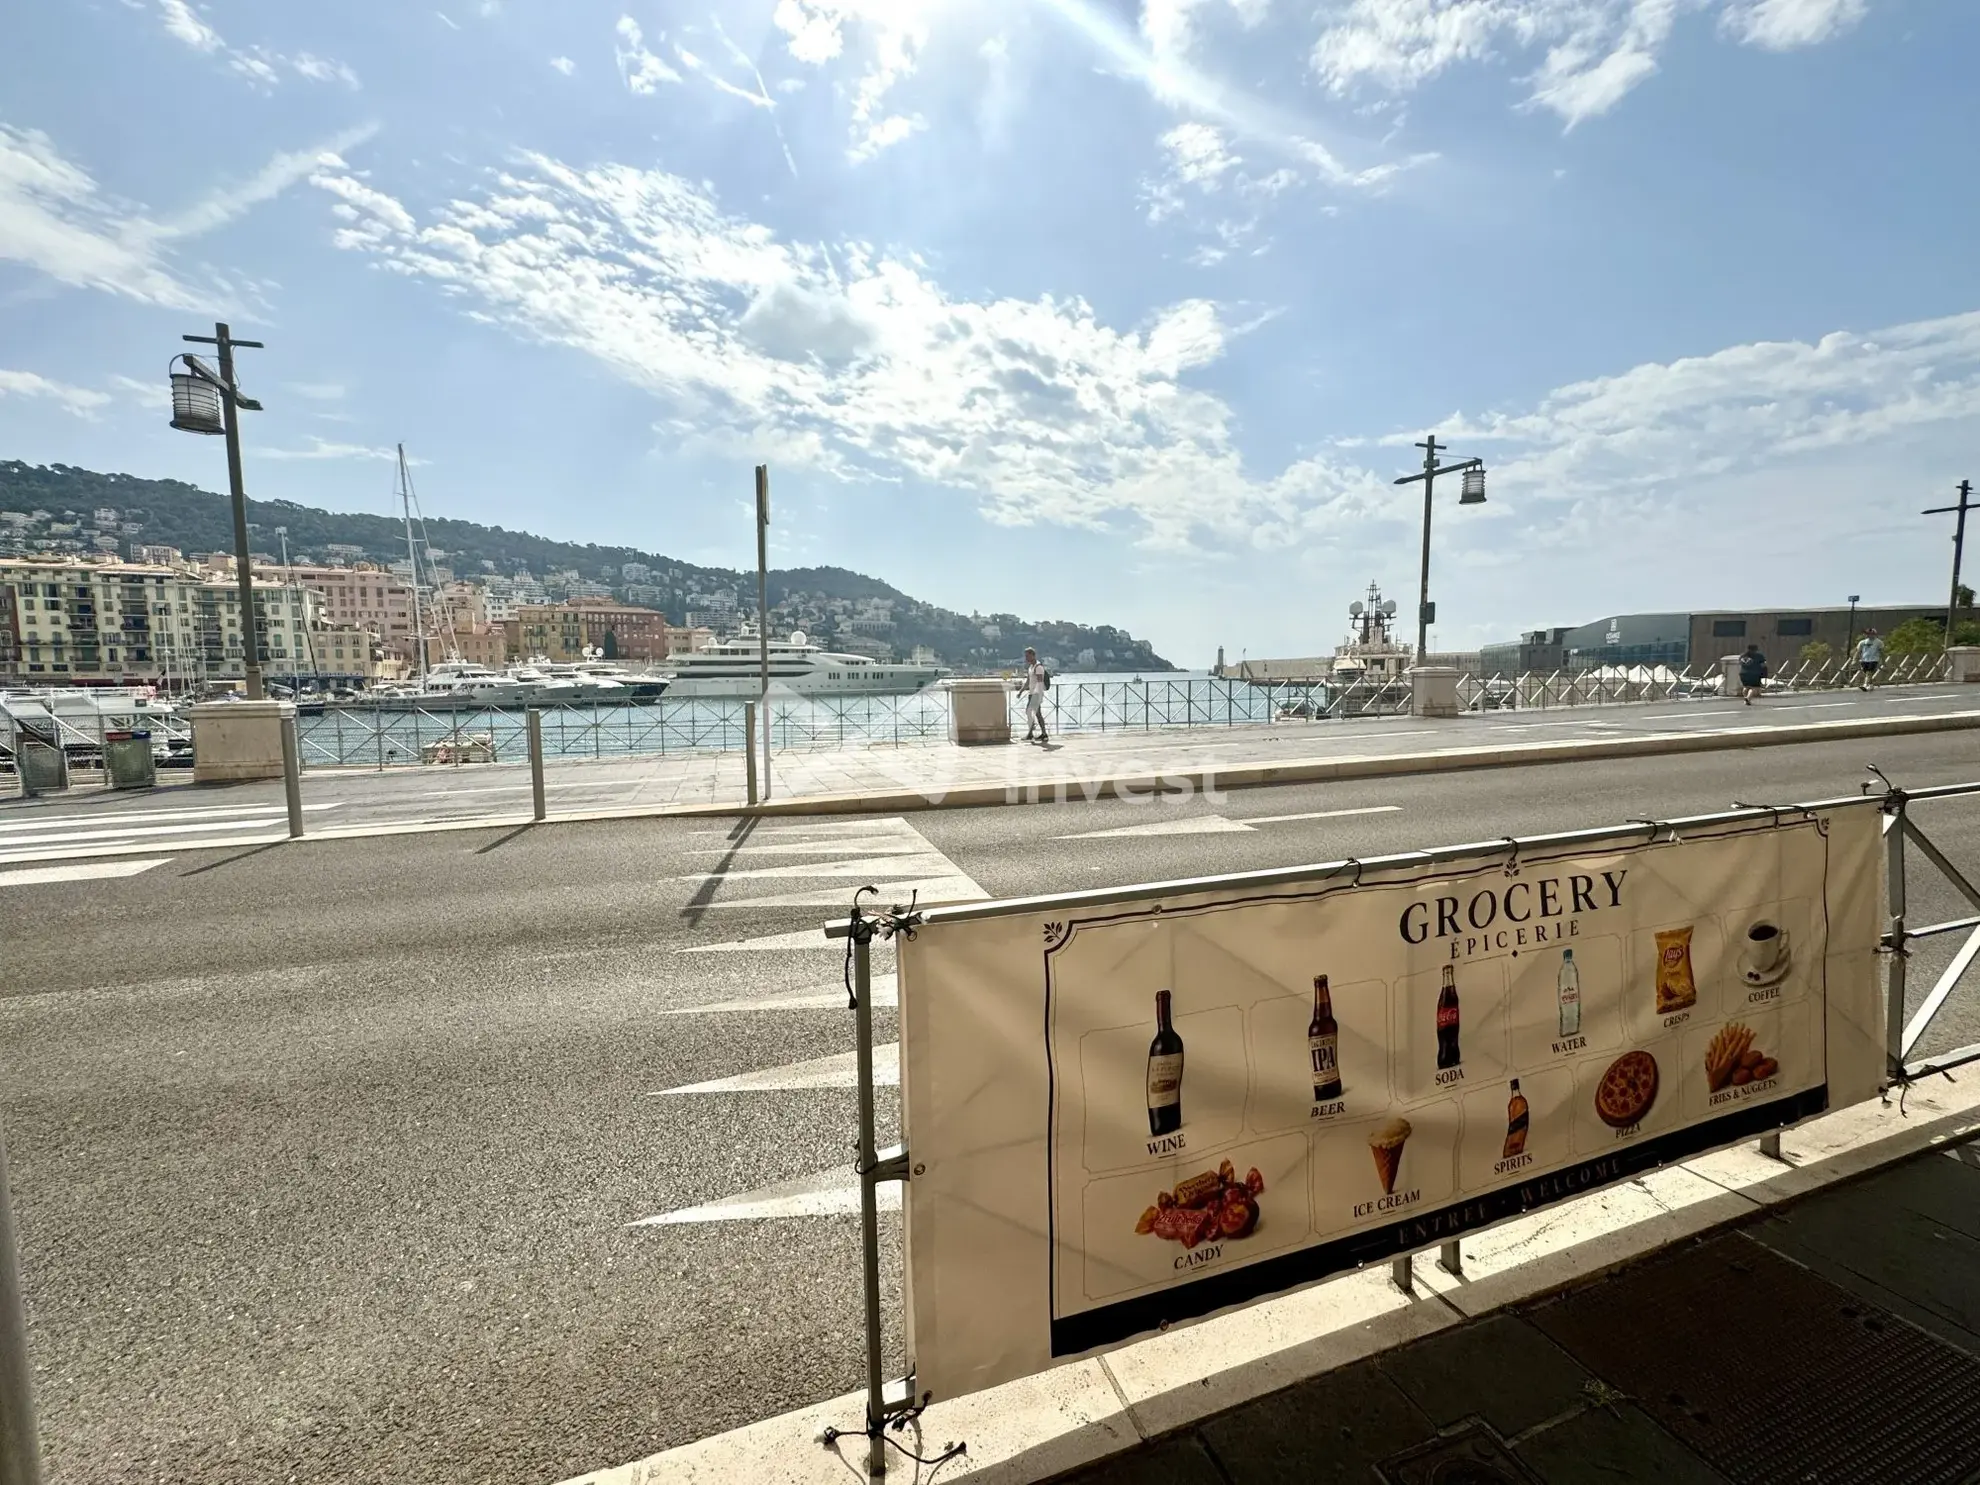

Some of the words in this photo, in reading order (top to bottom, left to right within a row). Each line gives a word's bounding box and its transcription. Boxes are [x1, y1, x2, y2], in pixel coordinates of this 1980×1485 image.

[1400, 870, 1628, 944] GROCERY
[1450, 919, 1580, 959] ÉPICERIE
[1748, 987, 1780, 1003] COFFEE
[1663, 1012, 1690, 1028] CRISPS
[1552, 1036, 1587, 1054] WATER
[1311, 1046, 1335, 1072] IPA
[1435, 1068, 1465, 1086] SODA
[1709, 1092, 1732, 1107] FRIES
[1733, 1088, 1741, 1099] &
[1741, 1079, 1778, 1096] NUGGETS
[1310, 1101, 1346, 1118] BEER
[1615, 1123, 1641, 1139] PIZZA
[1147, 1134, 1186, 1156] WINE
[1493, 1153, 1533, 1175] SPIRITS
[1520, 1157, 1620, 1204] WELCOME
[1353, 1201, 1374, 1218] ICE
[1377, 1190, 1420, 1211] CREAM
[1174, 1244, 1224, 1270] CANDY
